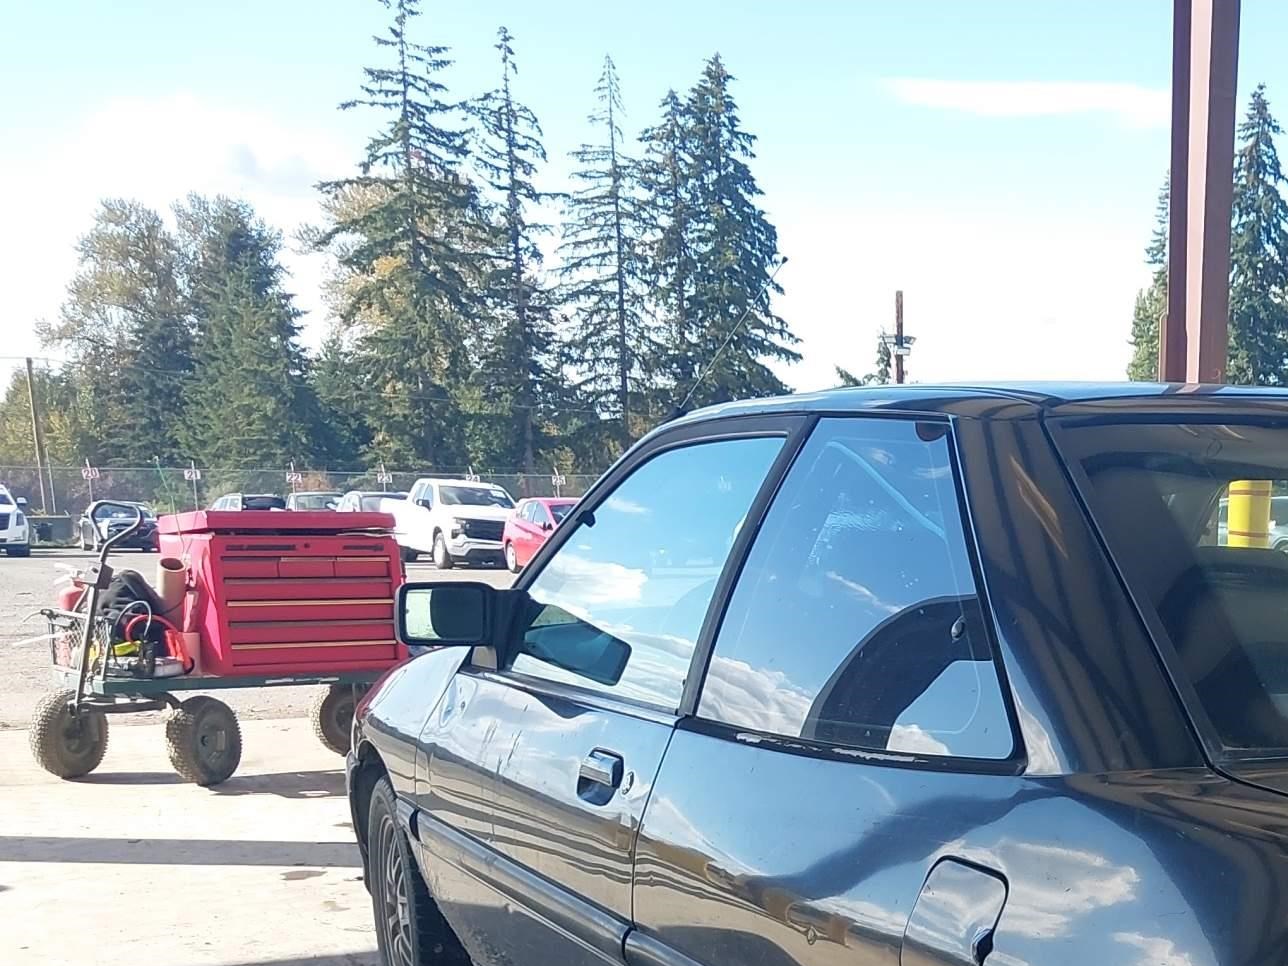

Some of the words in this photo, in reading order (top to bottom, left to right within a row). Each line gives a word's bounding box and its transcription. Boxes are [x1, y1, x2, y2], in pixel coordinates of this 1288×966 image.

[83, 469, 98, 478] 20
[187, 470, 199, 480] 21
[287, 472, 299, 482] 22
